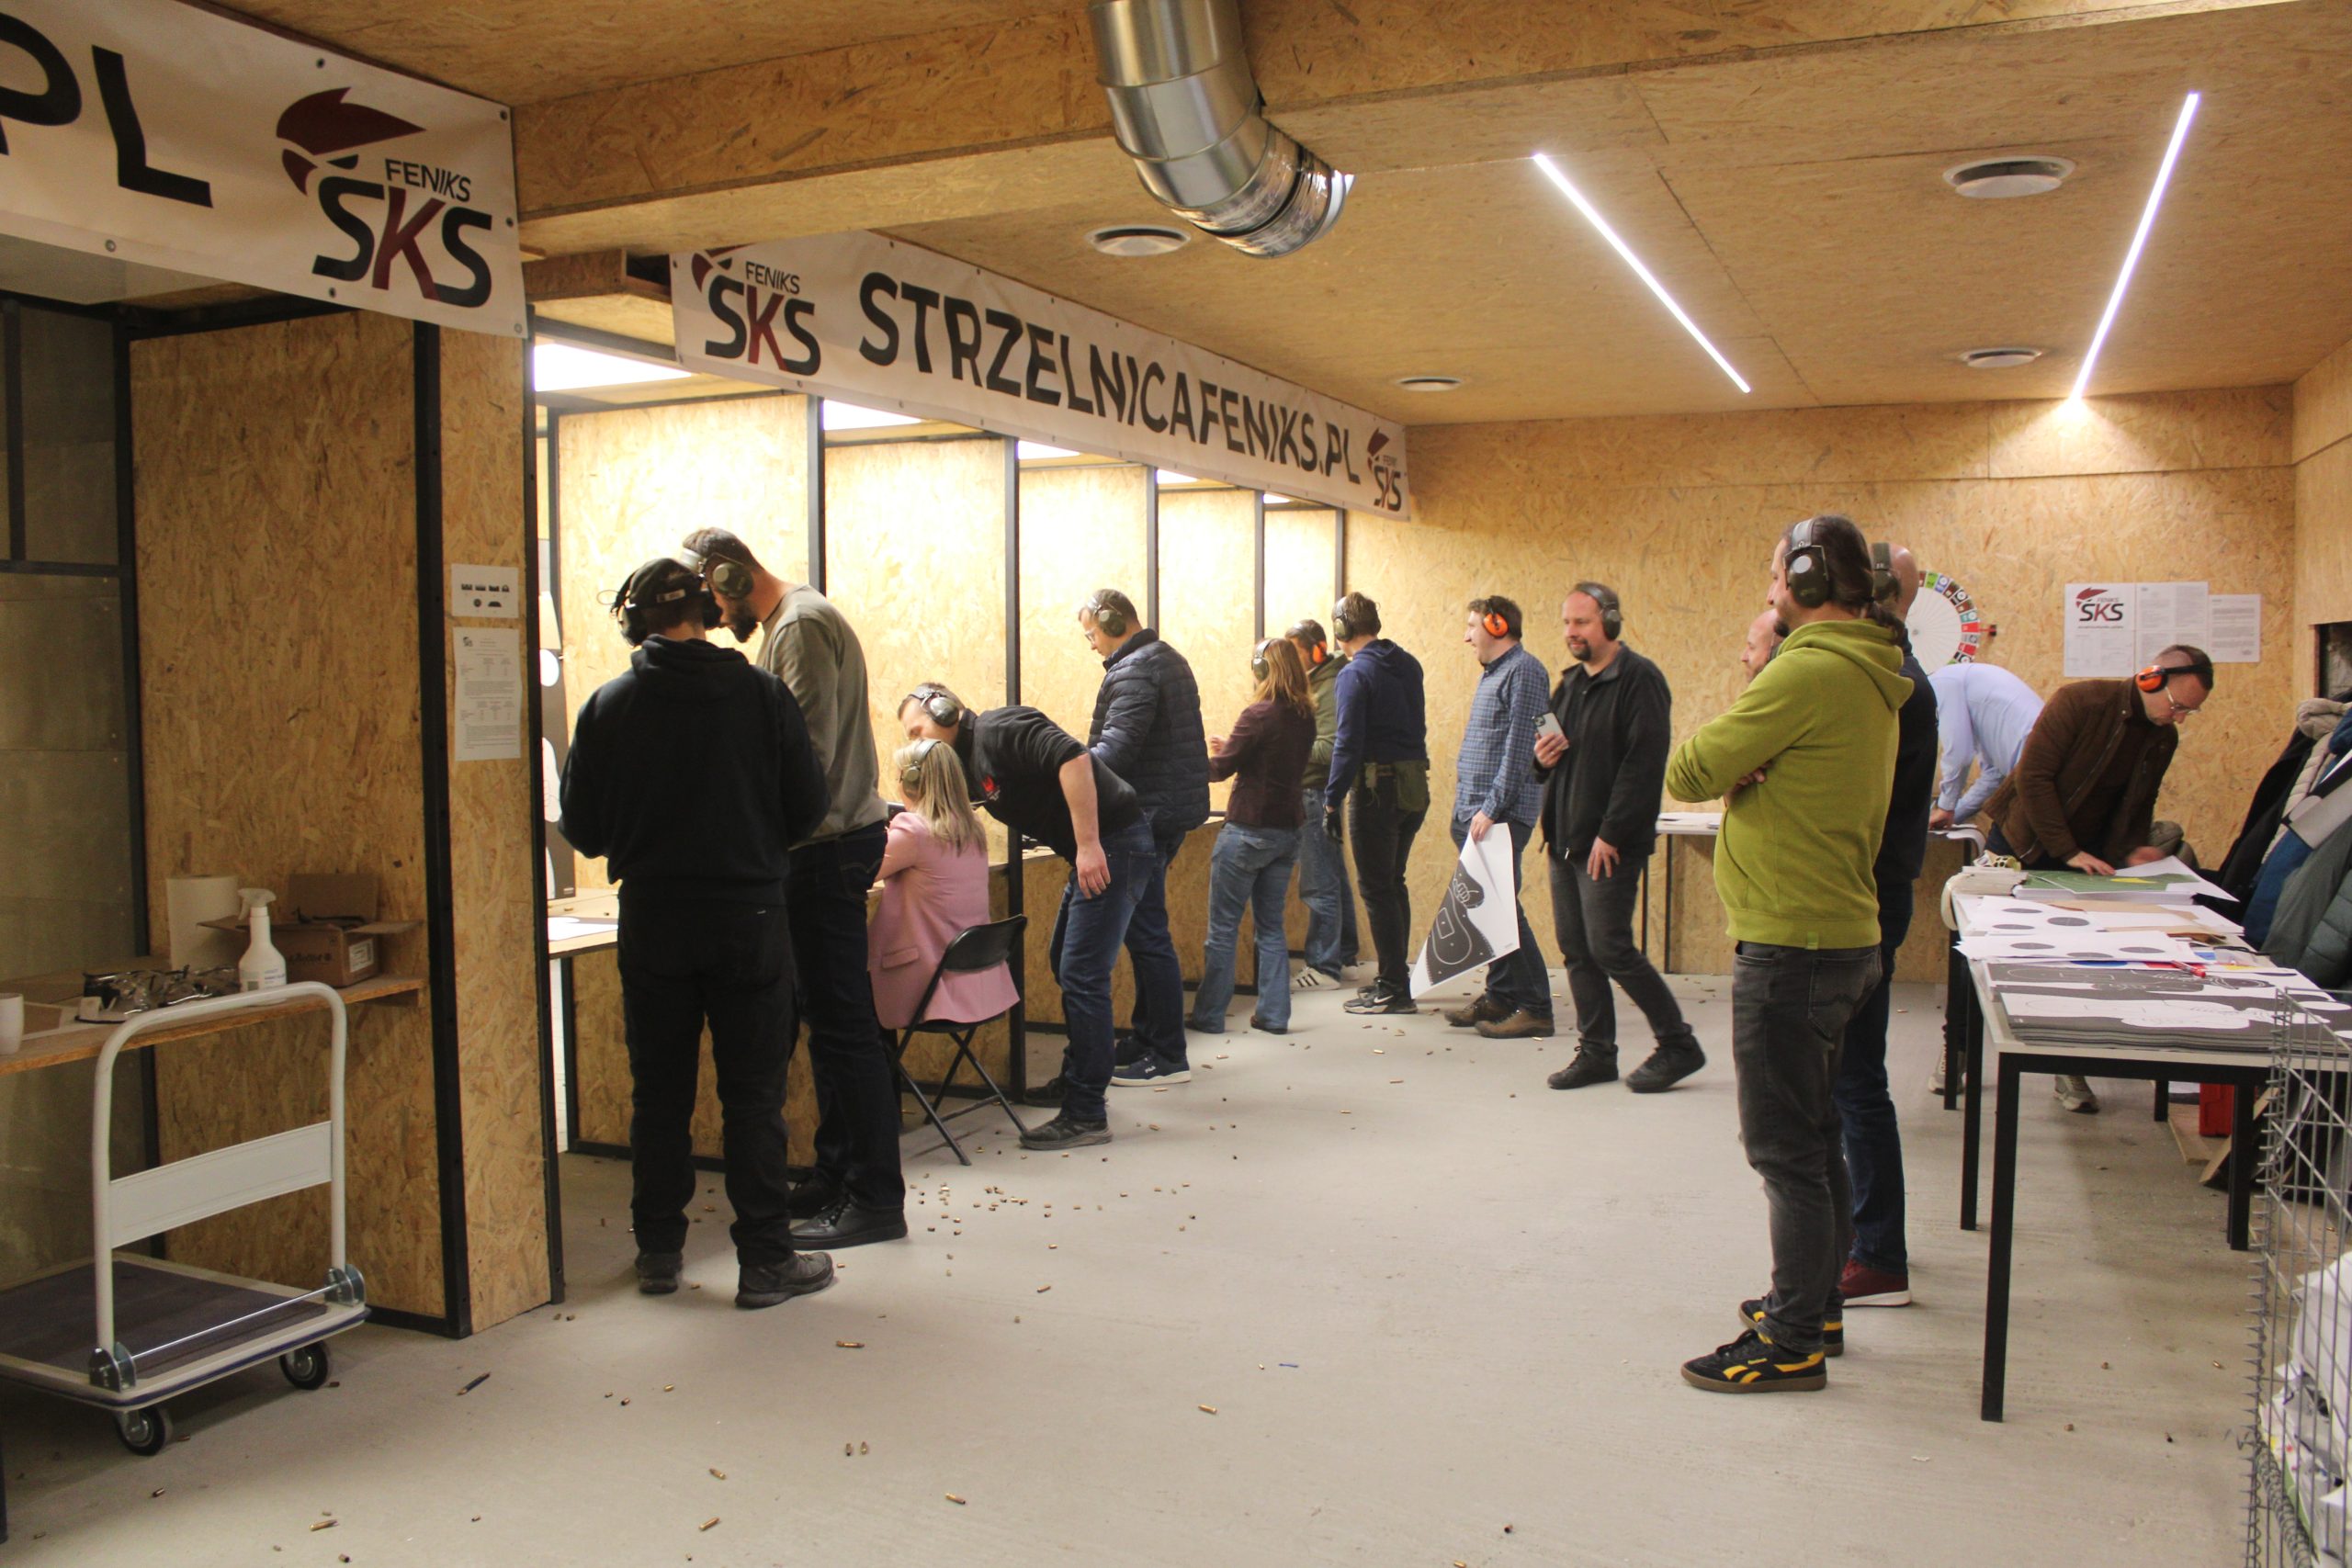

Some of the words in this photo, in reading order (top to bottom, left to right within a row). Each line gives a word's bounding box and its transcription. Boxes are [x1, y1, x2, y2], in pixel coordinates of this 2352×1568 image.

[385, 158, 471, 202] FENIKS
[312, 175, 492, 308] SKS
[745, 261, 800, 294] FENIKS
[705, 275, 821, 376] SKS
[859, 272, 1361, 485] STRZELNICAFENIKS.PL
[2079, 604, 2124, 622] SKS
